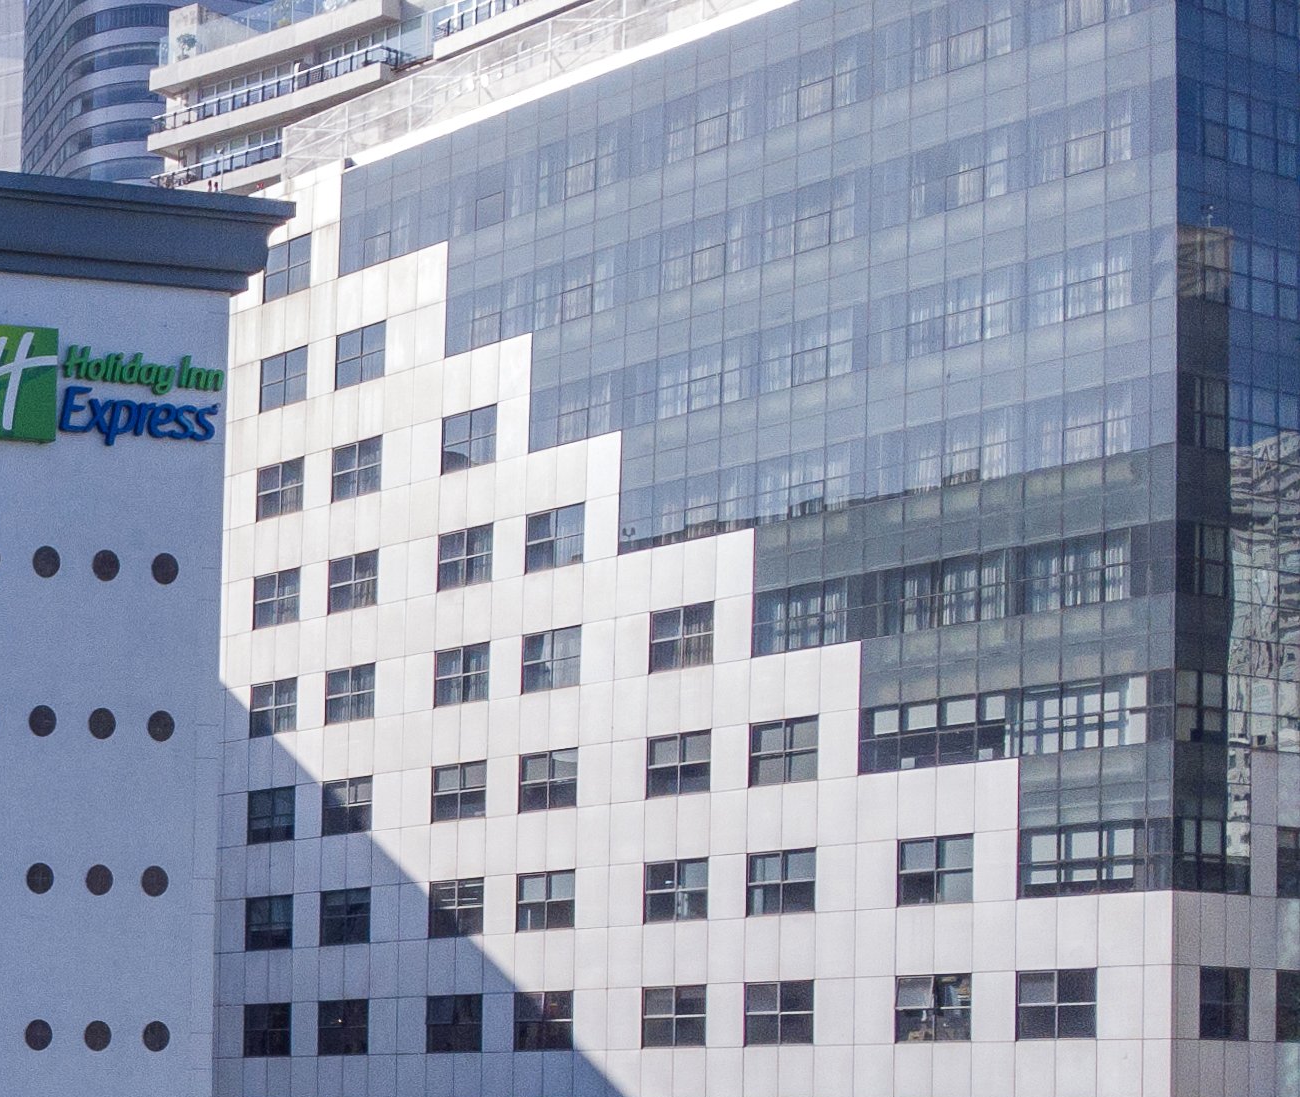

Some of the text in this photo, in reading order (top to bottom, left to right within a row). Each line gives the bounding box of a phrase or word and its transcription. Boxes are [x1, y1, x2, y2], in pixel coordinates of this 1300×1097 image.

[63, 344, 225, 396] Holiday Inn
[59, 386, 219, 446] Express
